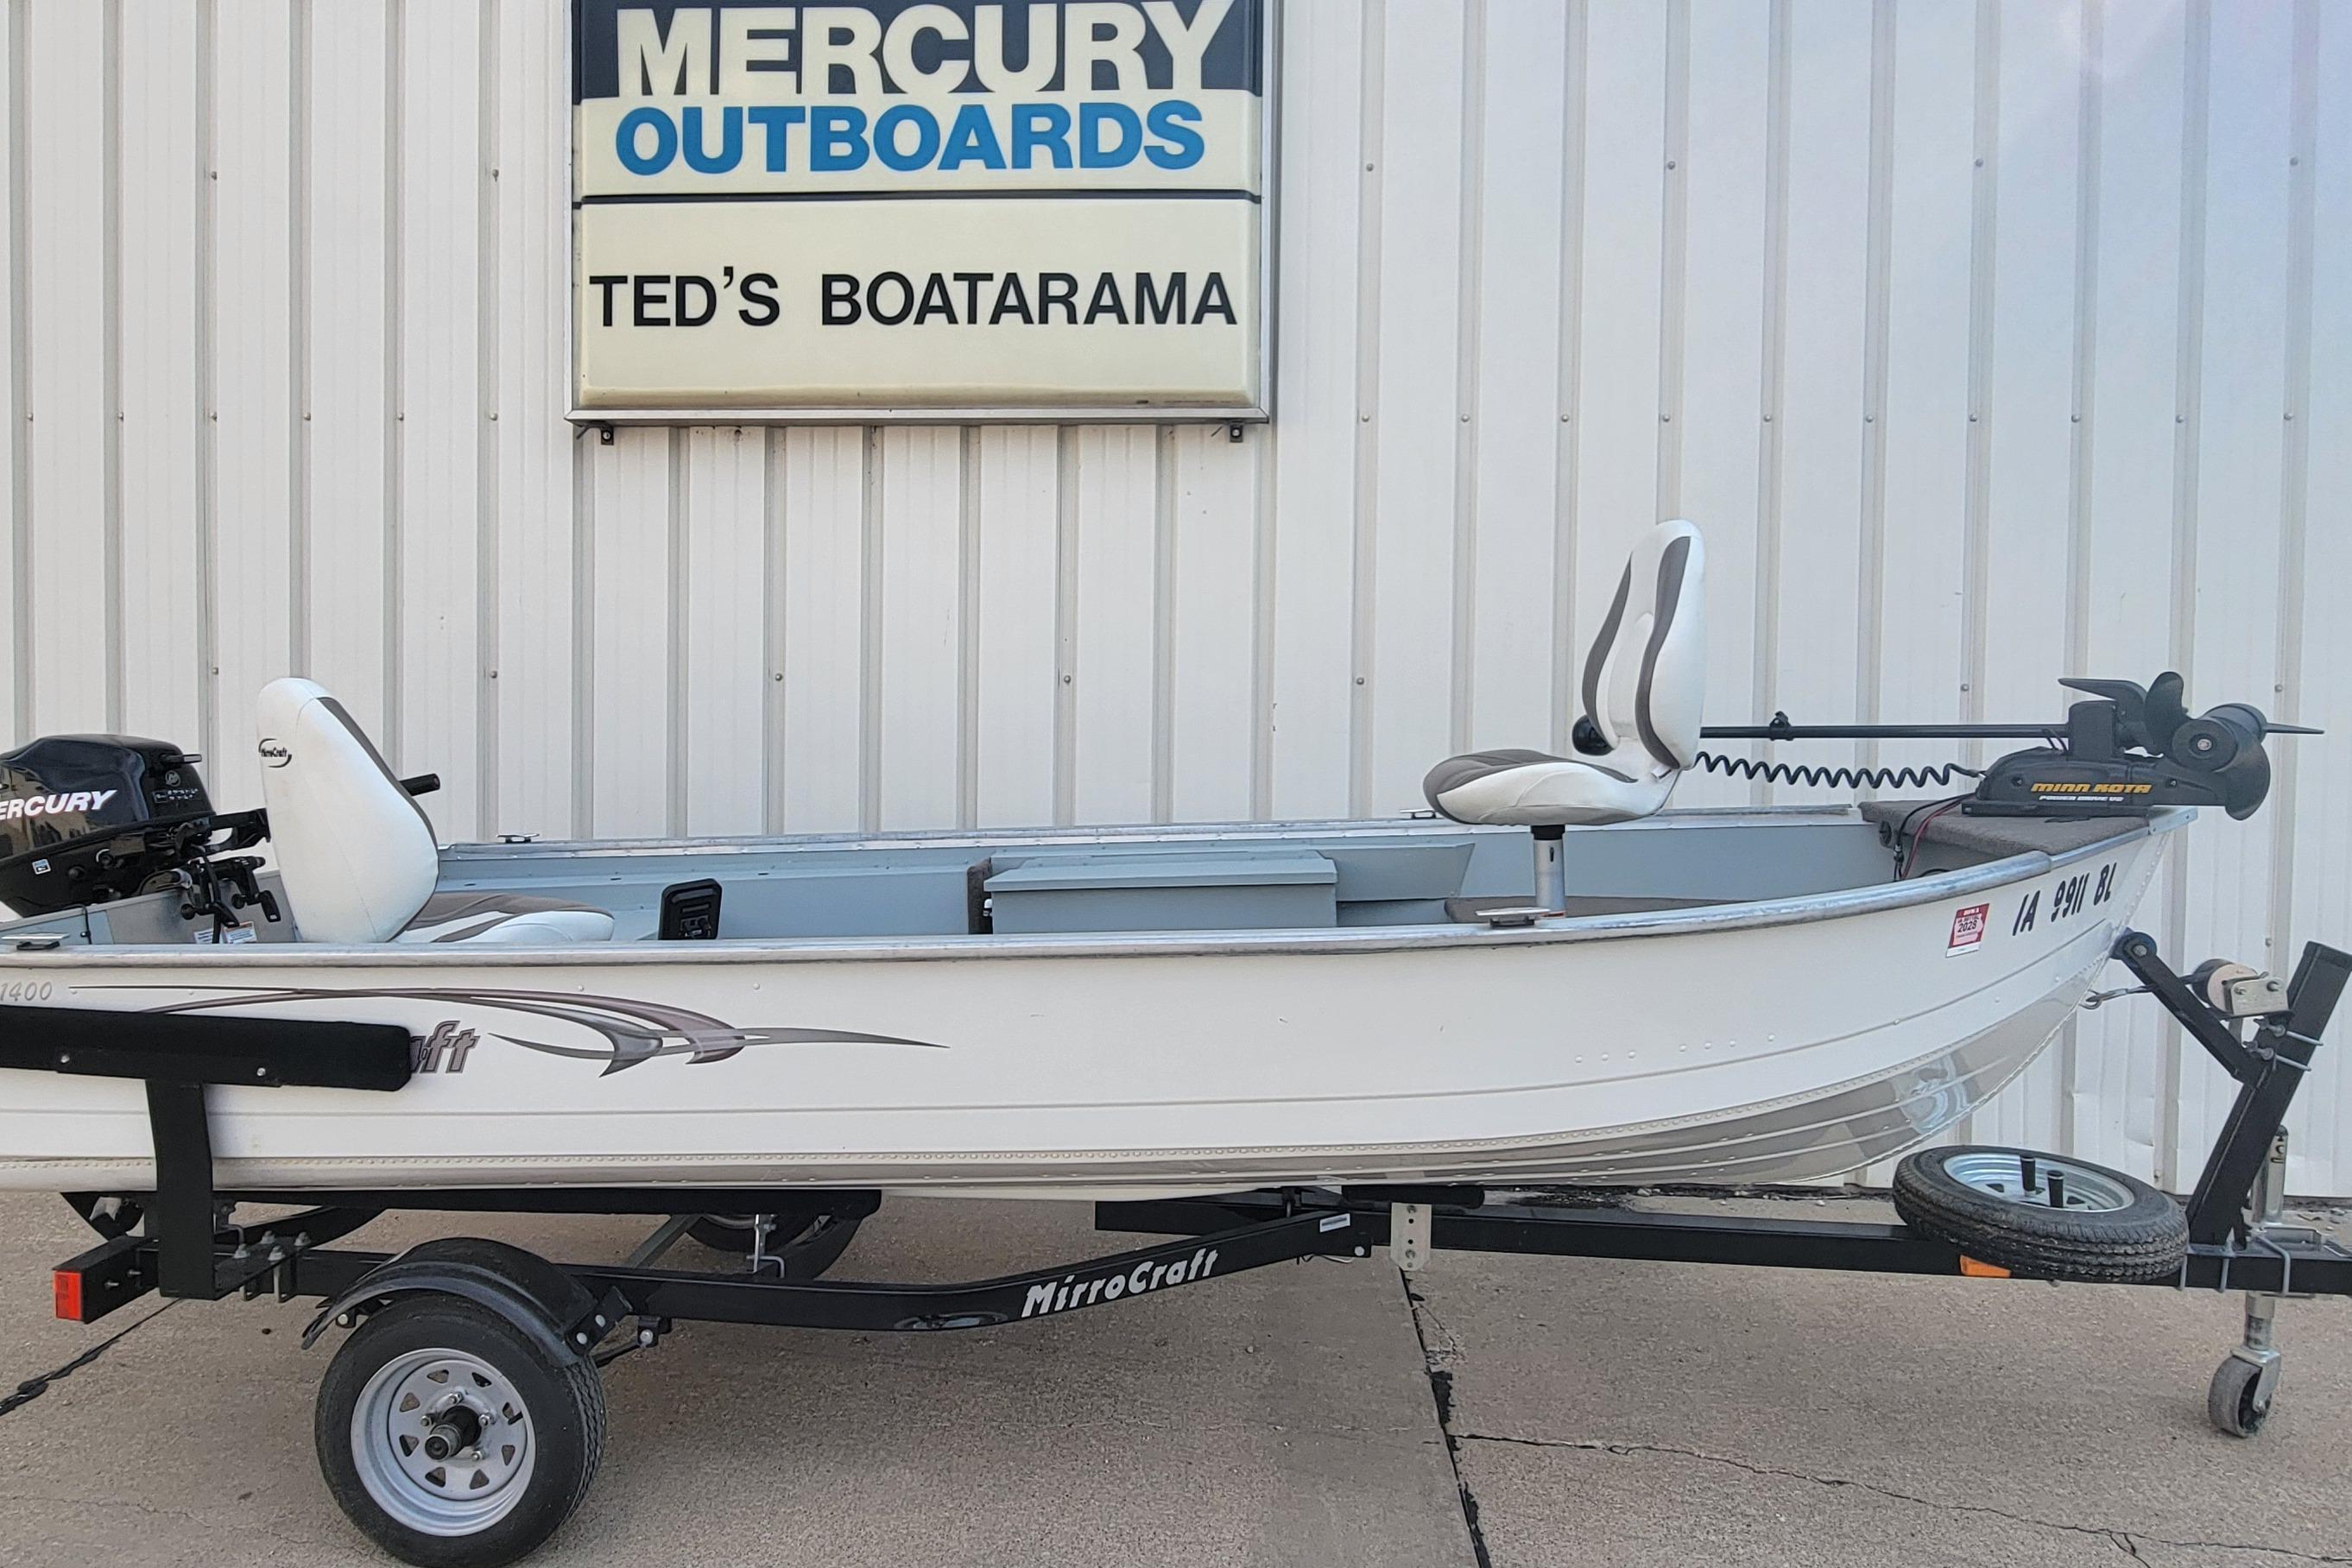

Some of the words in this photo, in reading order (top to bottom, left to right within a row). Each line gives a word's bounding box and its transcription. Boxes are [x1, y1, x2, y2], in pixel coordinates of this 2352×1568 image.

[616, 0, 1235, 96] MERCURY
[615, 100, 1205, 175] OUTBOARDS
[589, 266, 780, 327] TED'S
[822, 271, 1237, 326] BOATARAMA
[2051, 872, 2090, 922] 9911
[0, 982, 53, 1002] 1400
[1021, 1248, 1219, 1318] MirroCraft
